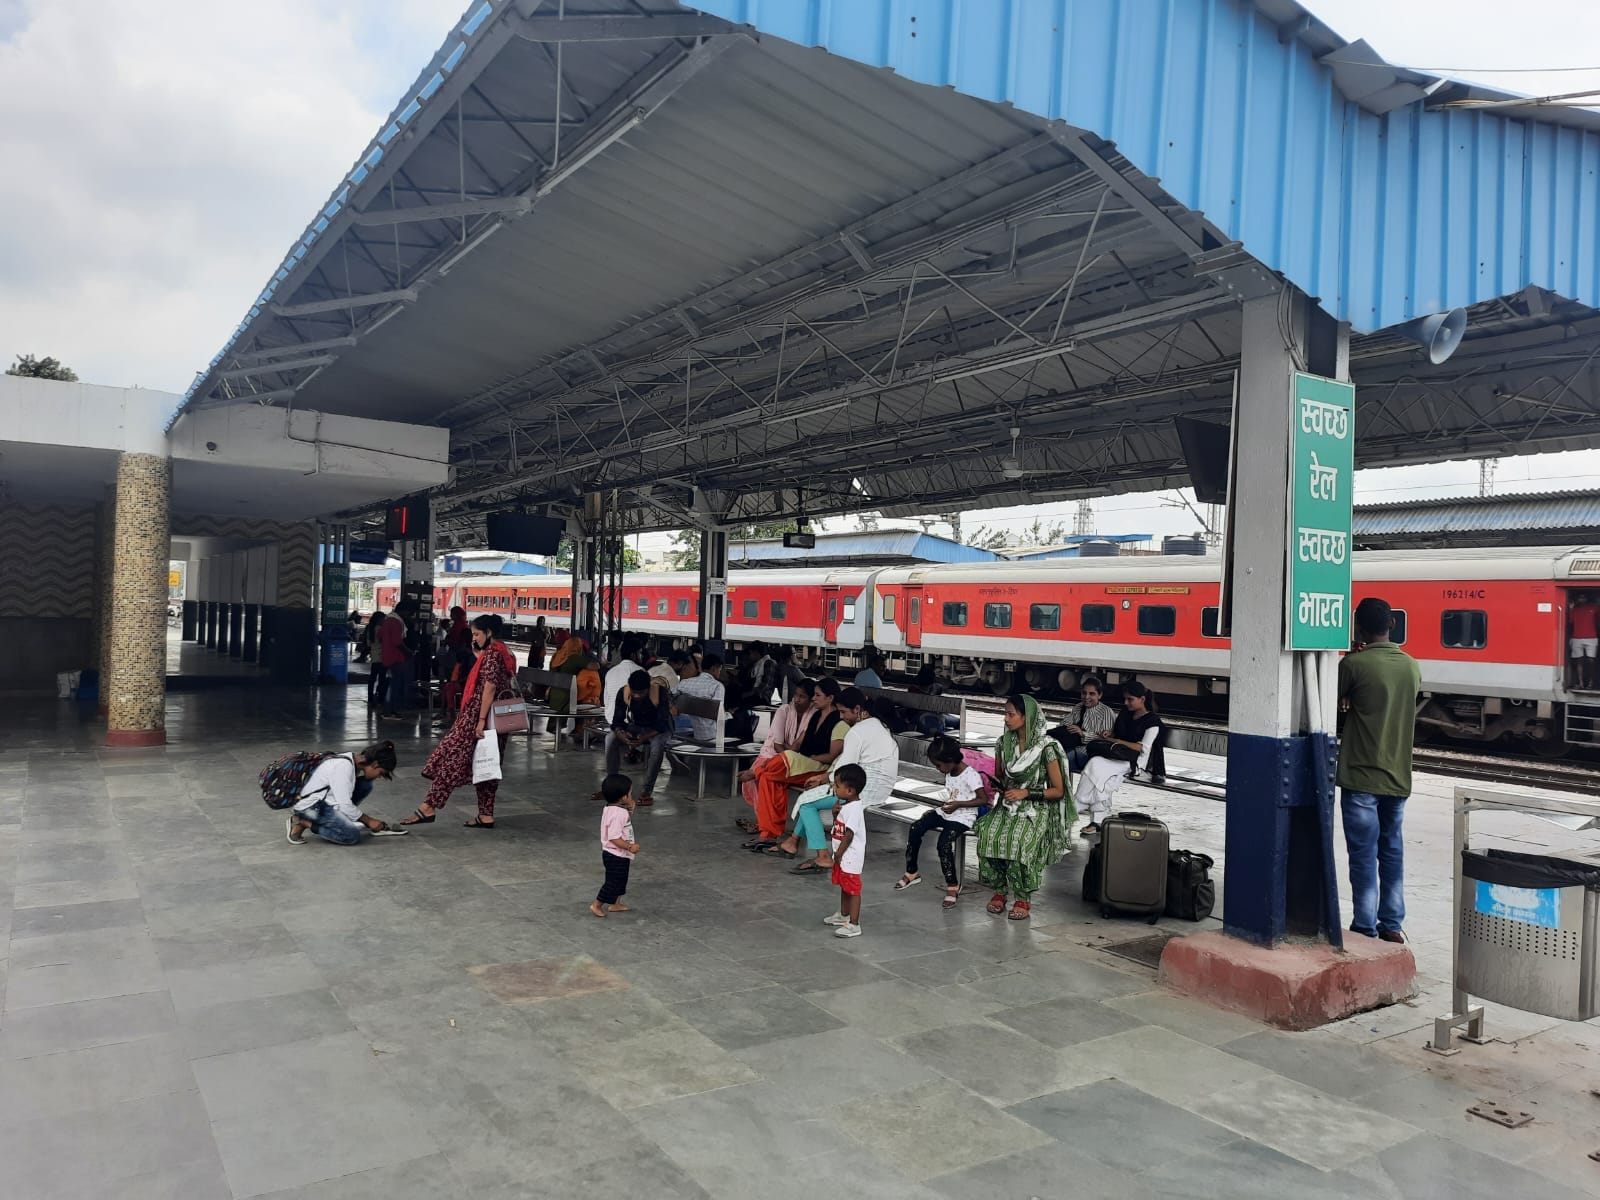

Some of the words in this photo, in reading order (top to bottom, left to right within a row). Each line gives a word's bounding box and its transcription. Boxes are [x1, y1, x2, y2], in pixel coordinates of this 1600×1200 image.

[1300, 398, 1348, 439] स्वच्छ
[1310, 450, 1338, 501] रेल
[450, 558, 458, 570] 1
[1298, 527, 1347, 565] स्वच्छ
[1298, 591, 1345, 628] भारत
[1442, 590, 1485, 599] 196214/C
